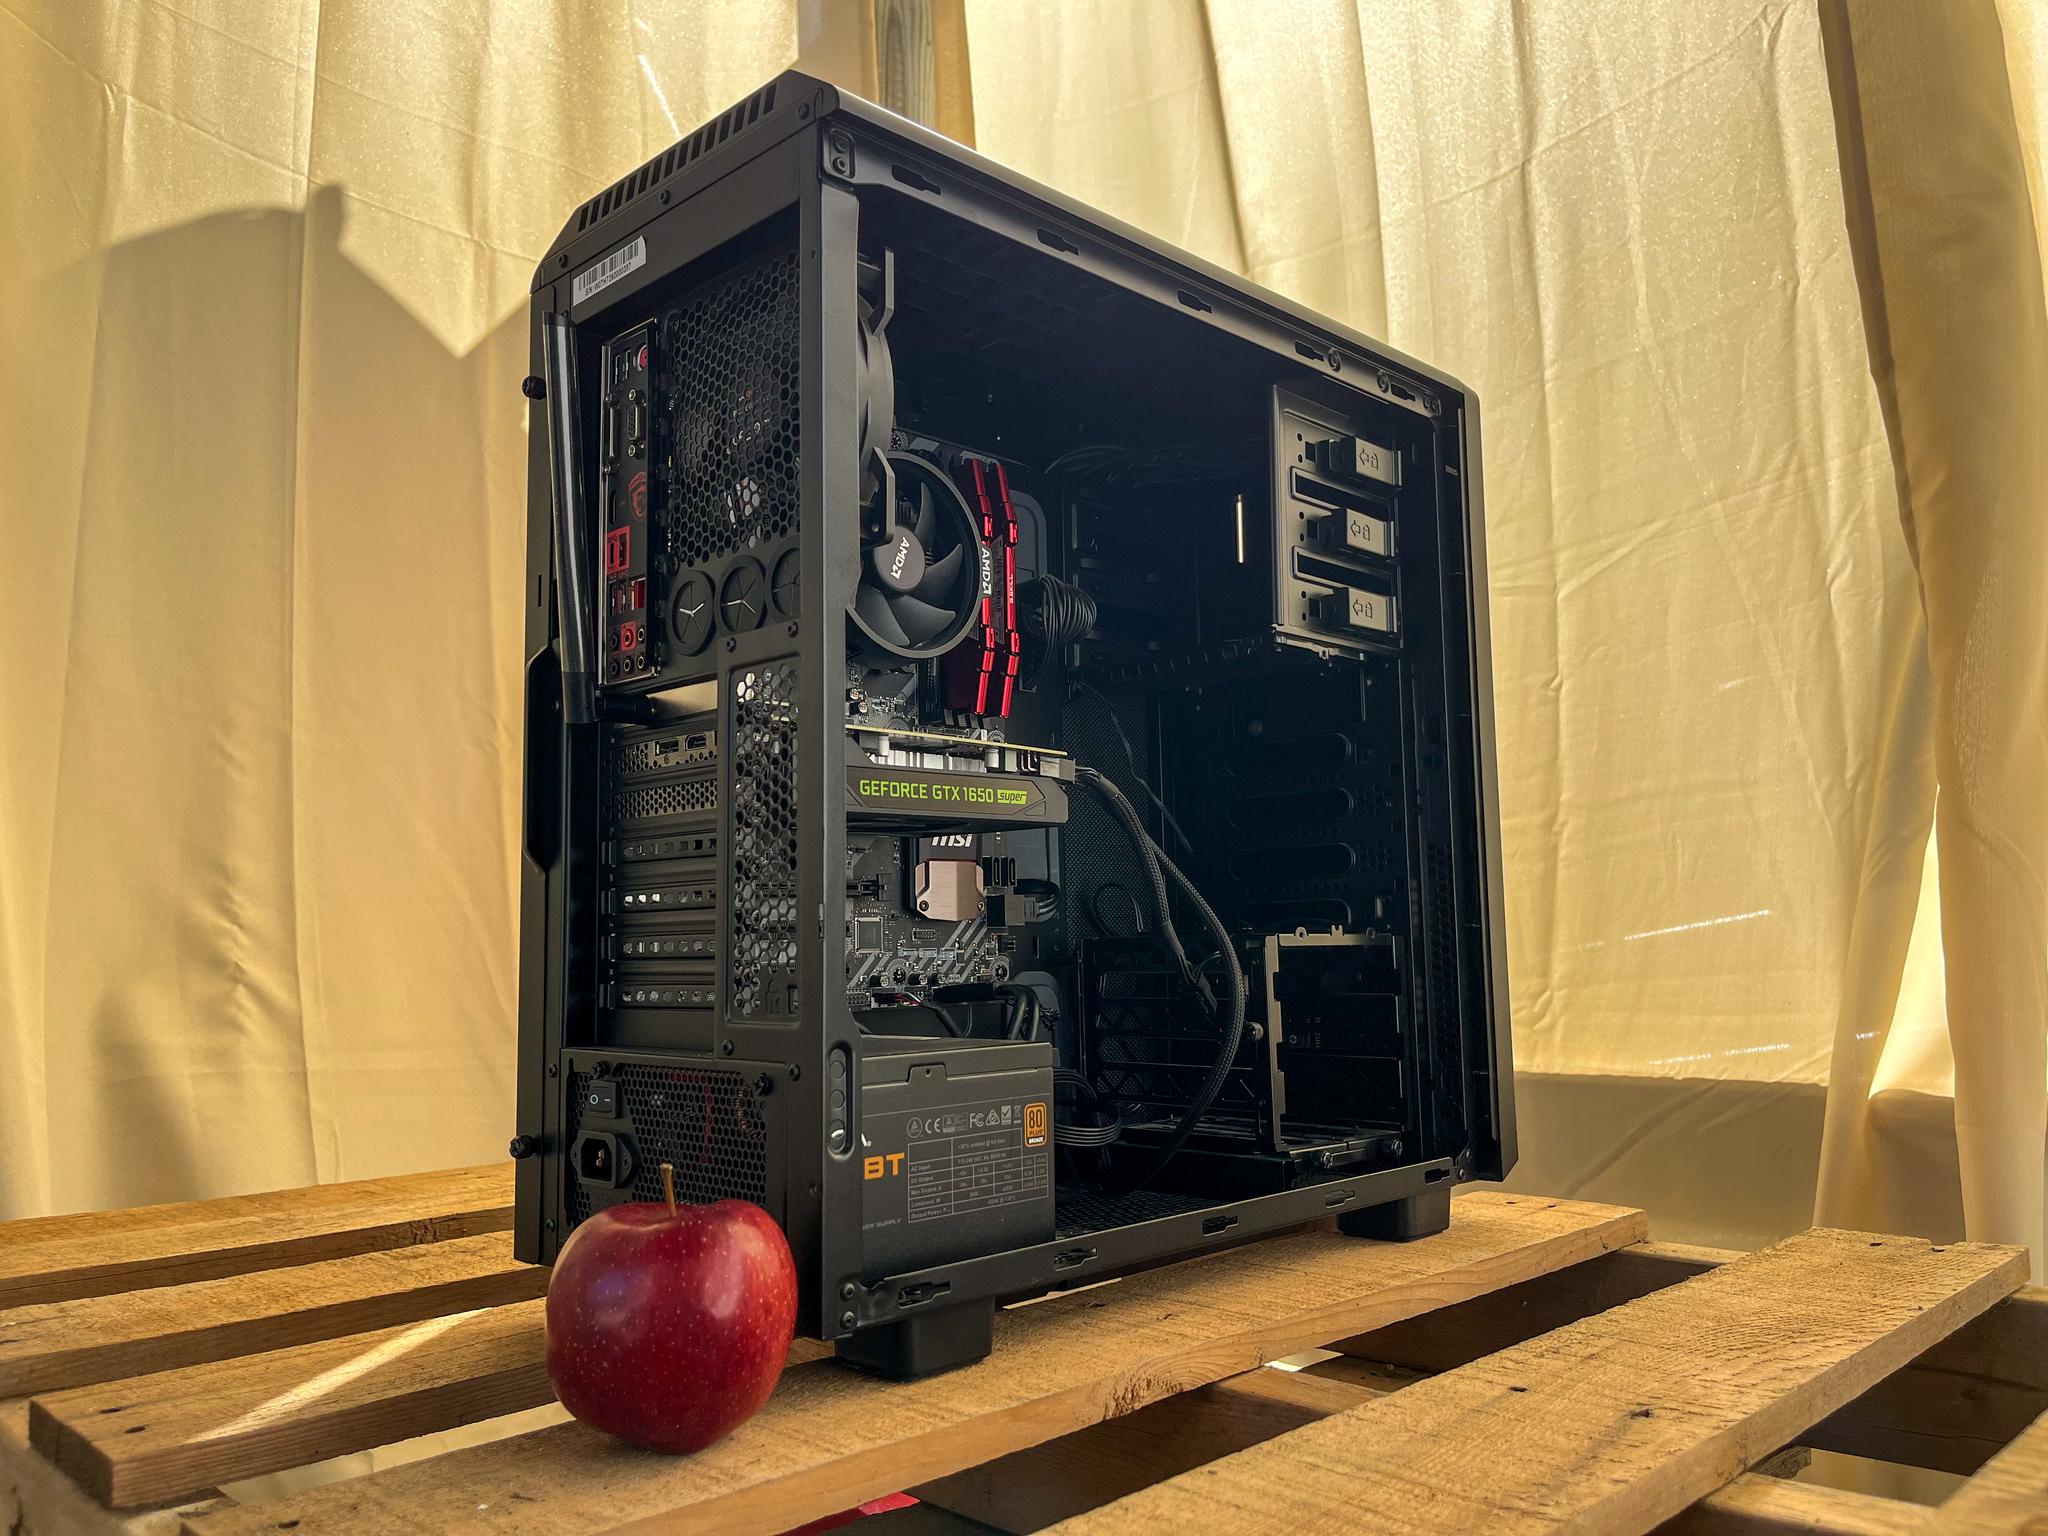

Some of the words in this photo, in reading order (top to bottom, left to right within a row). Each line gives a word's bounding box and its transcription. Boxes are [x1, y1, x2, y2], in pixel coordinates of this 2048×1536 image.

[894, 536, 911, 571] AMD
[981, 547, 992, 583] AMD
[859, 779, 928, 799] GEFORCE
[932, 784, 961, 802] GTX
[964, 786, 994, 803] 1650
[1028, 1108, 1043, 1129] 80
[1028, 1128, 1044, 1137] PLUS
[1028, 1136, 1044, 1144] BRONZE
[864, 1152, 905, 1180] BT
